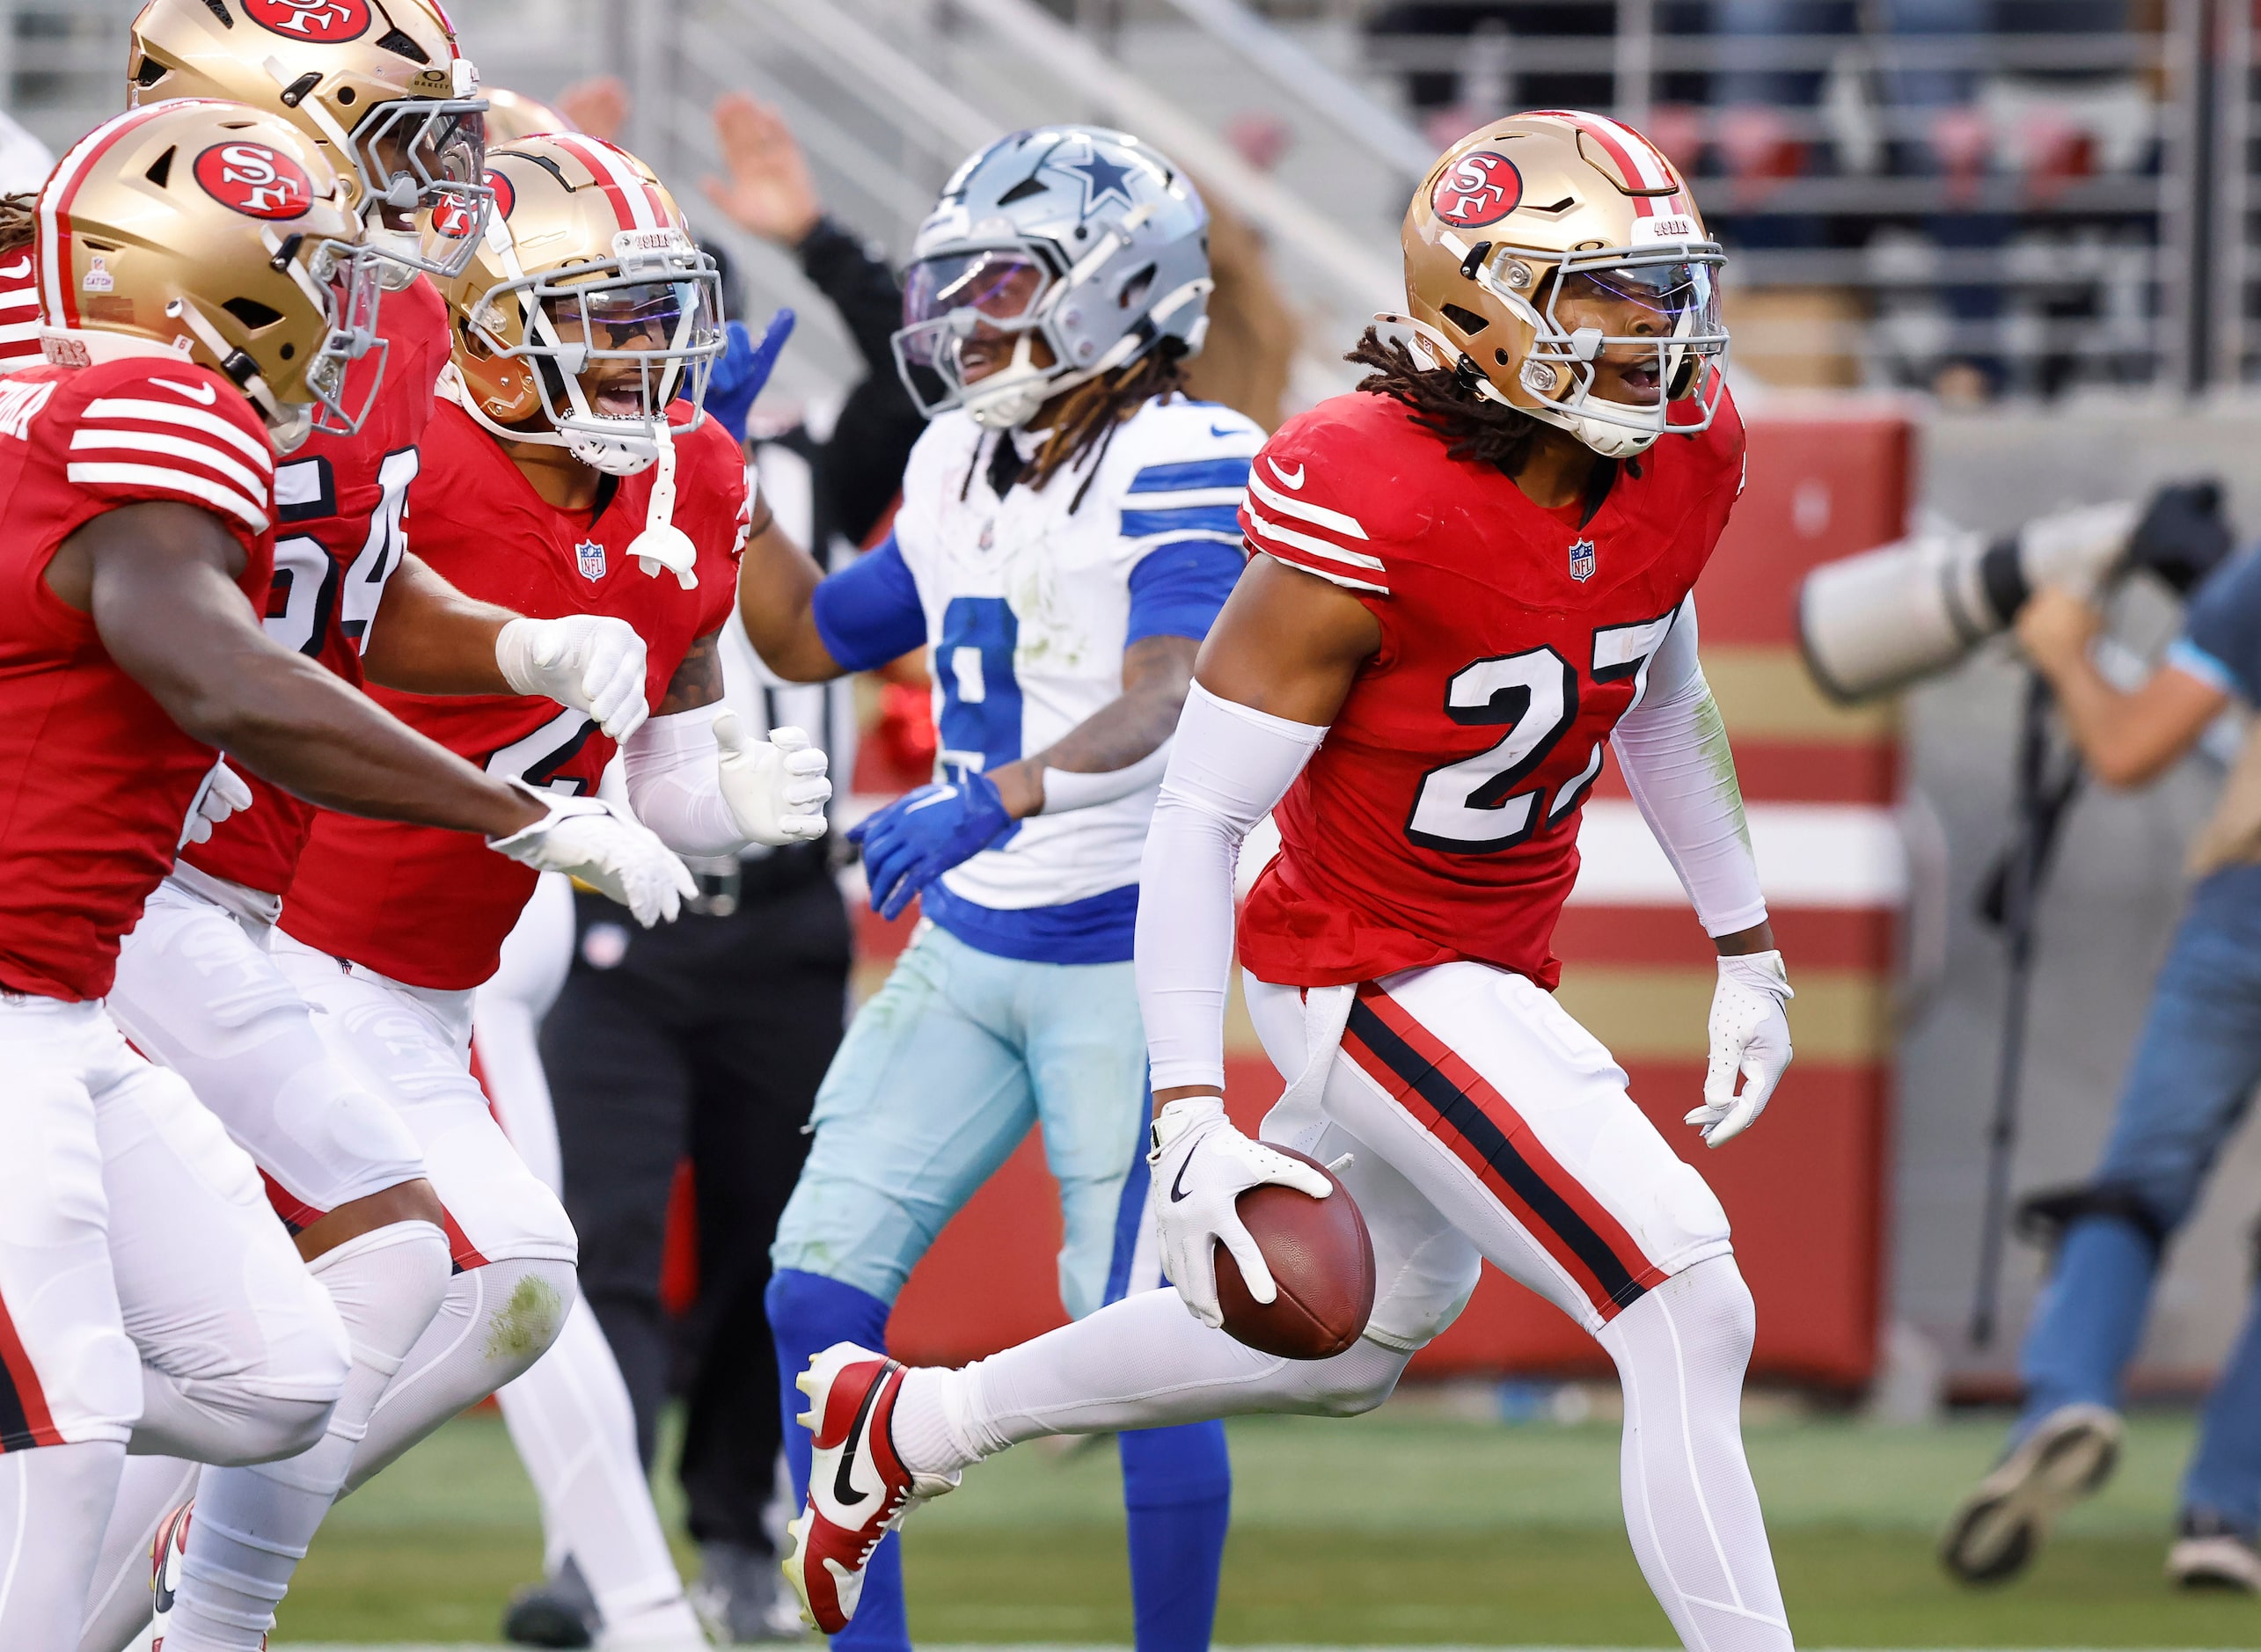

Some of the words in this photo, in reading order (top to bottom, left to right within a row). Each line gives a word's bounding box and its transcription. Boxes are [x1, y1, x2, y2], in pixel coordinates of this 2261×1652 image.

[414, 80, 450, 90] OAKLEY
[220, 145, 300, 211] SF
[1445, 157, 1505, 219] SF
[1654, 220, 1689, 237] 49ERS
[261, 444, 421, 661] 54
[583, 558, 603, 574] NFL
[1573, 558, 1593, 575] NFL
[1404, 602, 1681, 855] 27
